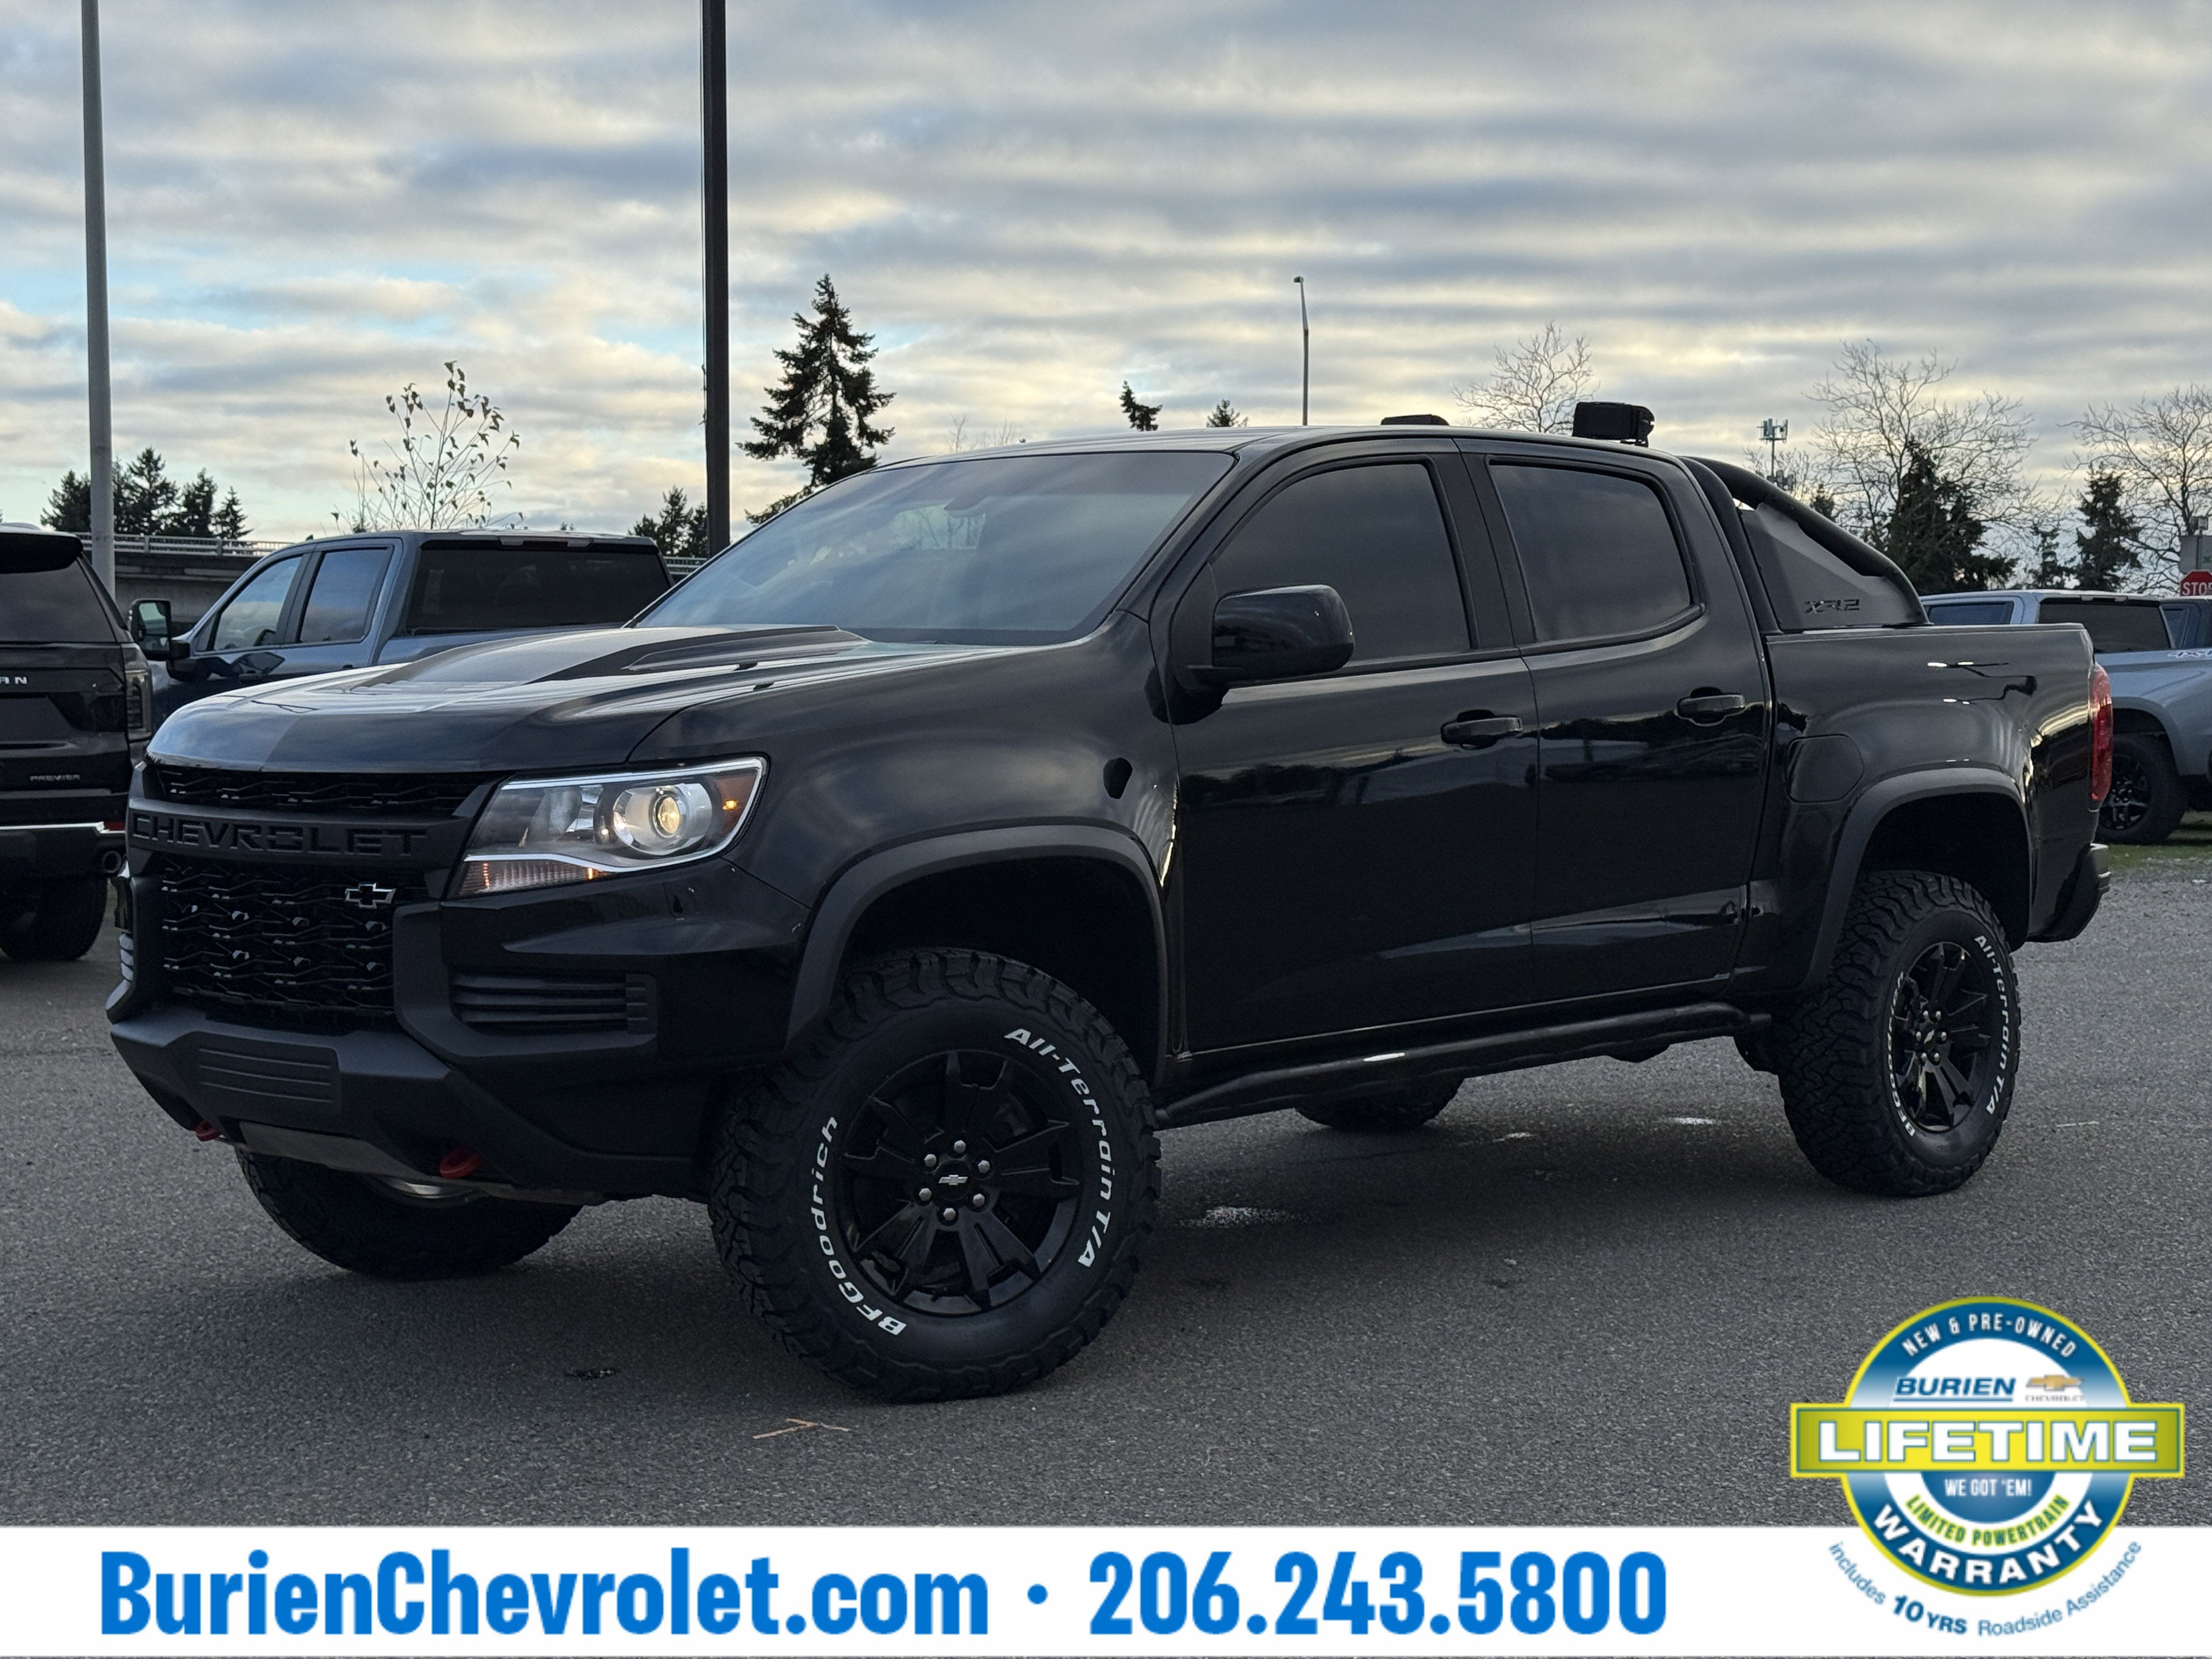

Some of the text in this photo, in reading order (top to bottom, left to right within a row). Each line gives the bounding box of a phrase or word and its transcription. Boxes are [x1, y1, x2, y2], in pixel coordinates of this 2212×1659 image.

[132, 813, 427, 856] CHEVROLET
[1974, 935, 2010, 1115] All-Terrain T/A
[811, 1116, 907, 1335] BFGoodrich
[1004, 1029, 1115, 1267] All-Terrain T/A
